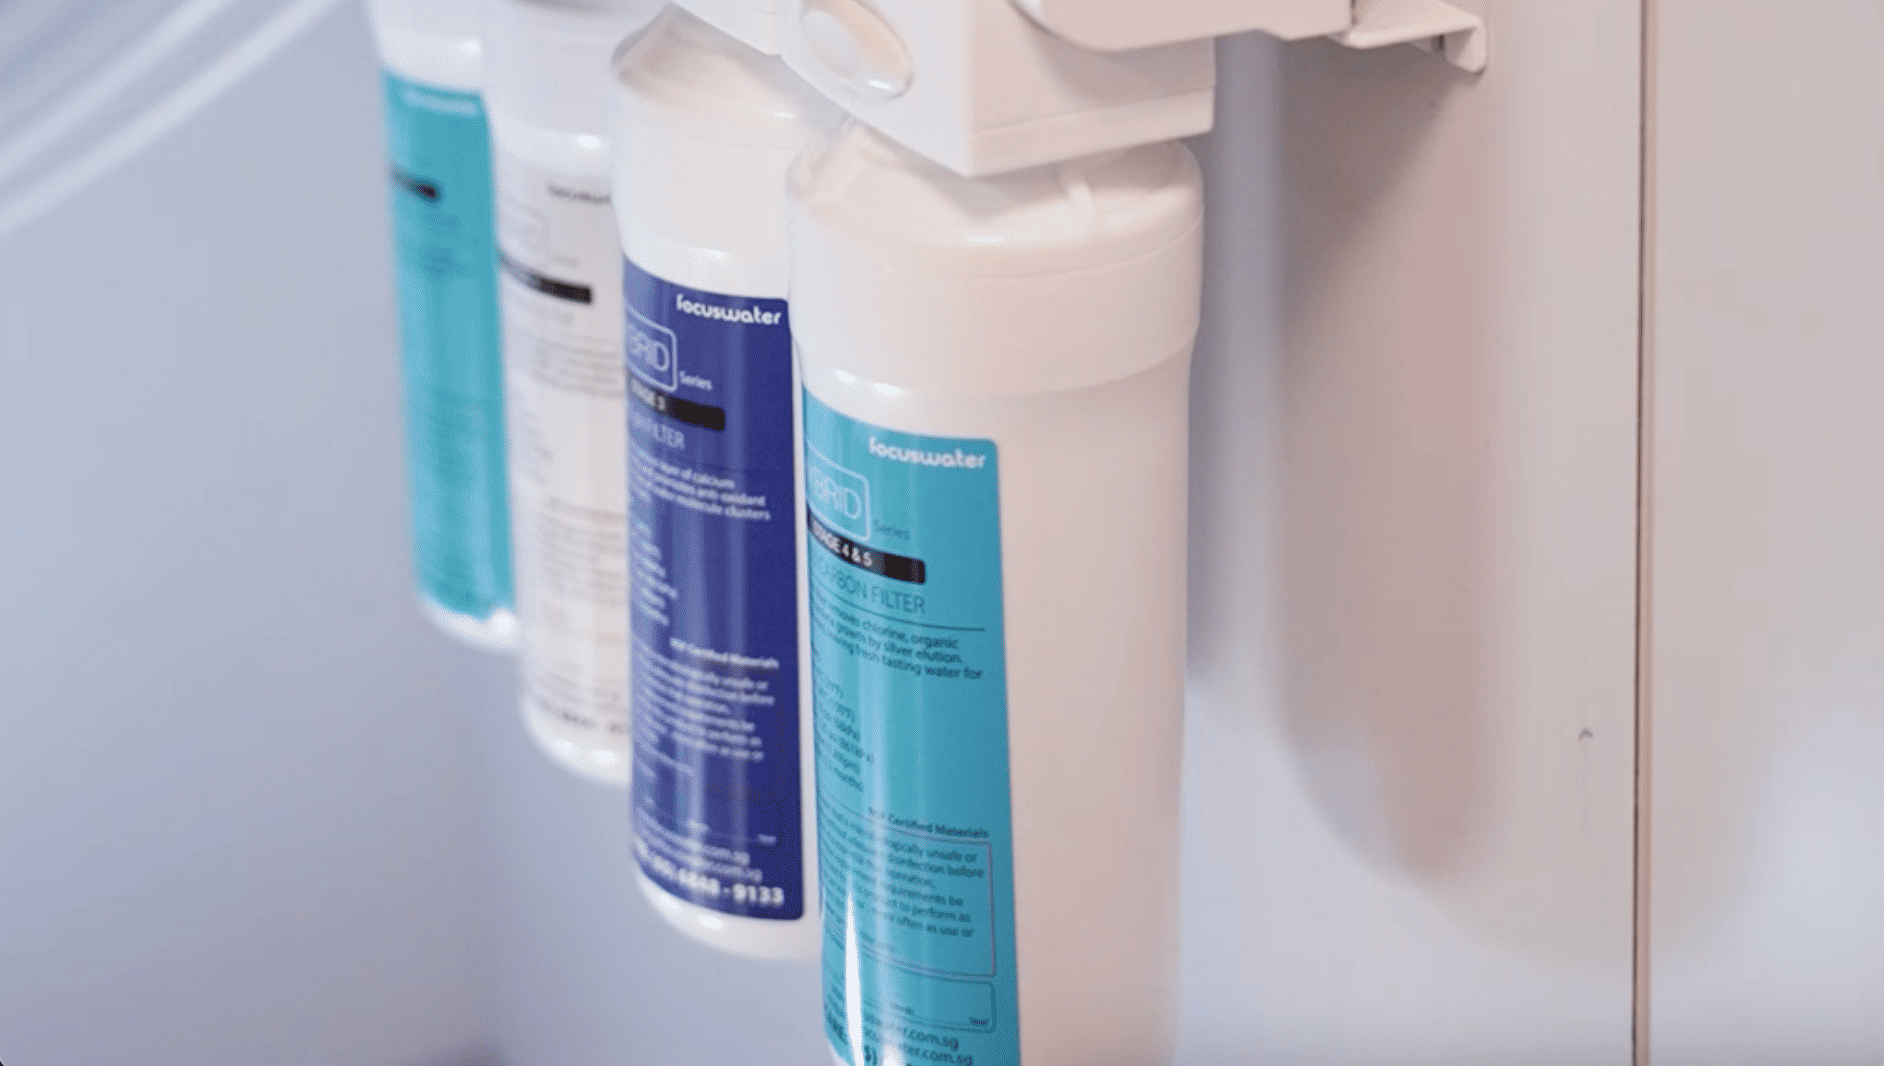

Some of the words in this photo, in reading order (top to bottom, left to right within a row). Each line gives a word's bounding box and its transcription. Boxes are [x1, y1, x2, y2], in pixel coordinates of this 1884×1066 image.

[676, 294, 782, 325] focuswater
[867, 435, 986, 469] focuswater
[851, 547, 863, 564] &
[863, 551, 874, 568] 5
[871, 585, 926, 615] FILTER
[911, 634, 959, 652] organic
[882, 653, 922, 677] tasting
[925, 662, 961, 678] water
[963, 665, 984, 681] for
[887, 813, 934, 833] Certified
[935, 823, 990, 839] Materials
[964, 852, 978, 863] or
[947, 865, 985, 879] before
[732, 883, 784, 906] 9133
[911, 904, 957, 921] perform
[958, 912, 972, 924] as
[939, 925, 960, 938] use
[960, 928, 976, 939] or
